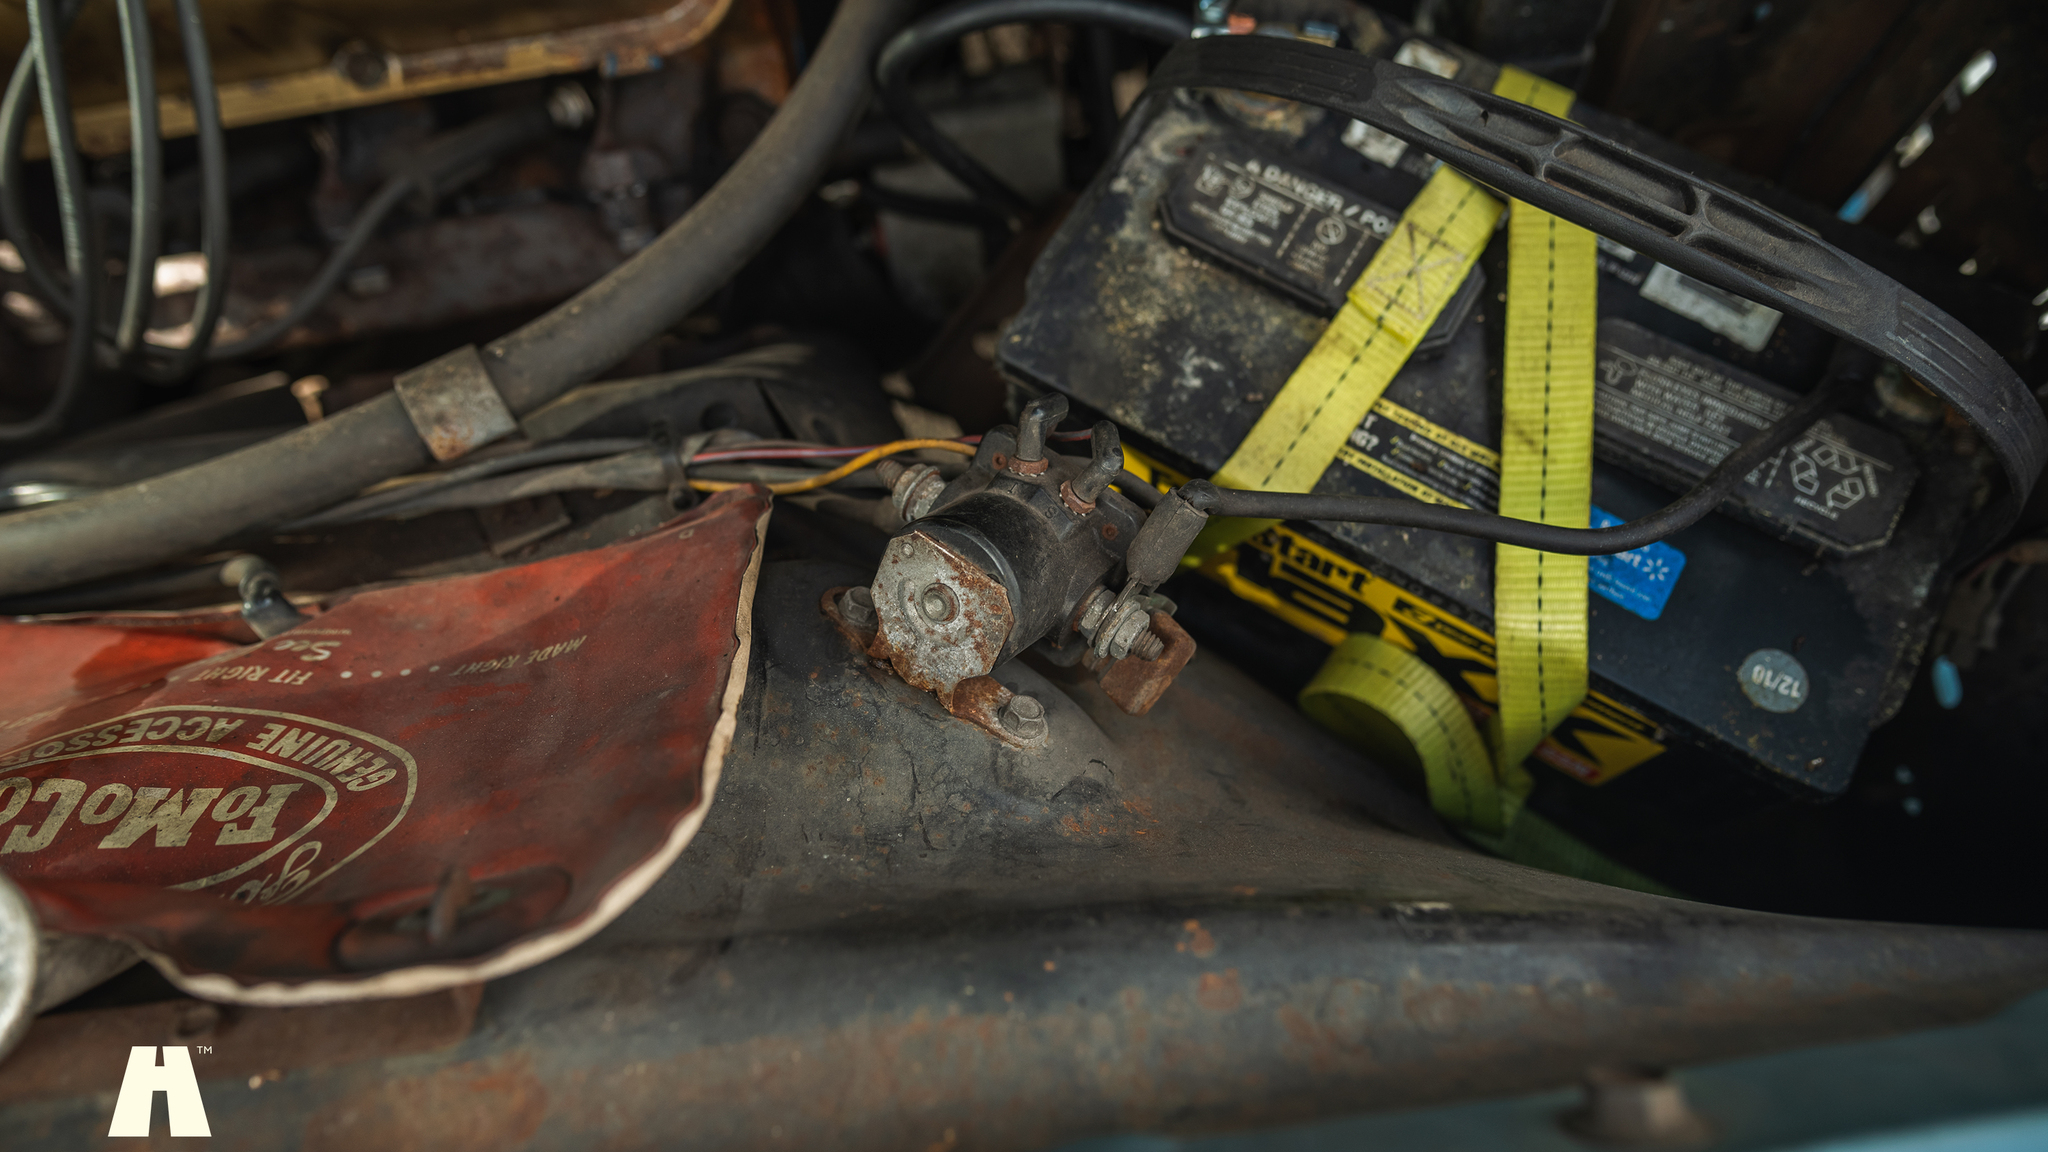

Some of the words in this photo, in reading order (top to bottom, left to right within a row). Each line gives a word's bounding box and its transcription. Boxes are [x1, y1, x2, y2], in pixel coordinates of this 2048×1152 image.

[1264, 164, 1344, 213] DANGER
[450, 654, 520, 676] RIGHT
[524, 635, 587, 665] MADE
[188, 664, 271, 683] RIGHT
[268, 669, 314, 685] FIT
[1751, 664, 1801, 698] 12/10
[246, 722, 398, 792] GENUINE
